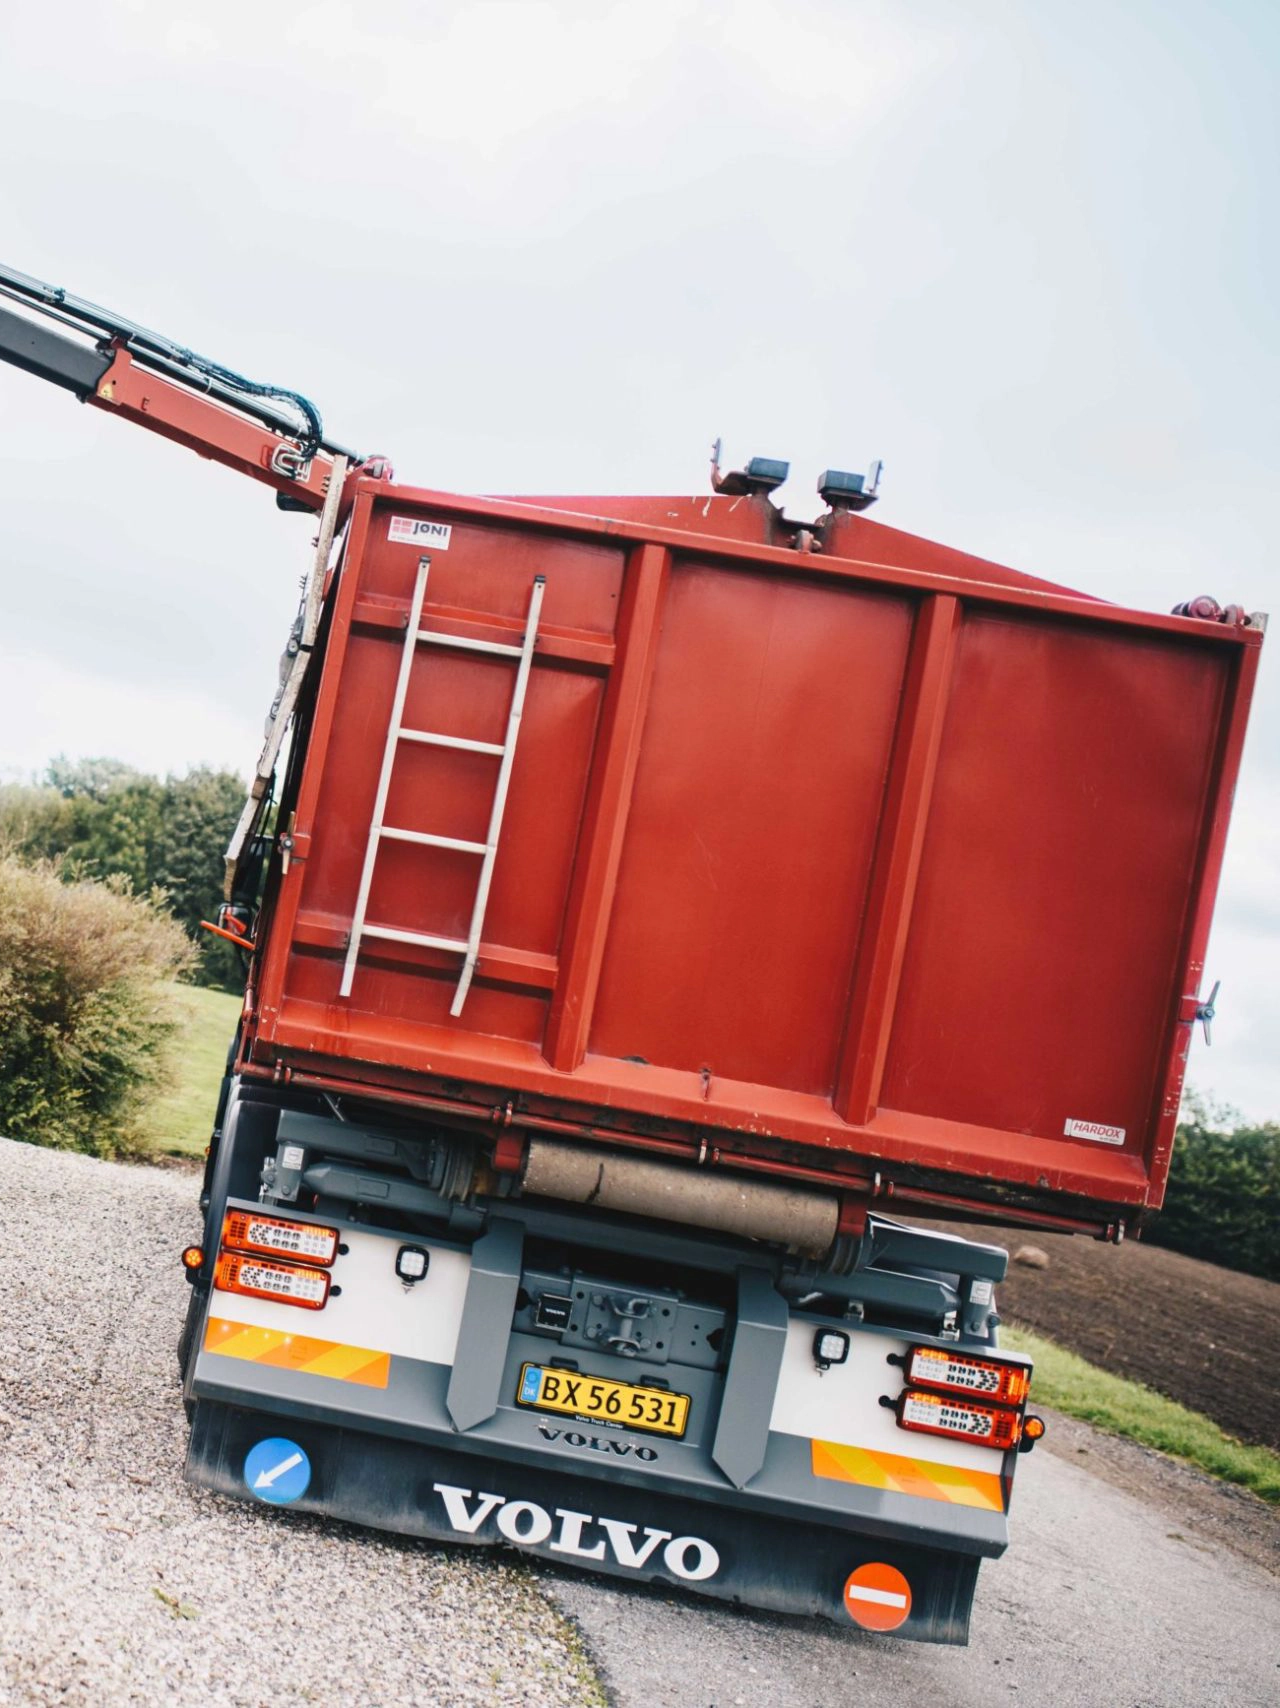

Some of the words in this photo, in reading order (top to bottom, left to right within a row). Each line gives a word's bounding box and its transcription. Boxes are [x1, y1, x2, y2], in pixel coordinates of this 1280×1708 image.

[1073, 1122, 1121, 1138] HARDOX
[523, 1387, 536, 1397] DK
[542, 1375, 582, 1407] BX
[587, 1385, 621, 1415] 56
[628, 1394, 677, 1428] 531
[538, 1425, 658, 1461] VOLVO
[432, 1482, 720, 1581] VOLVO
